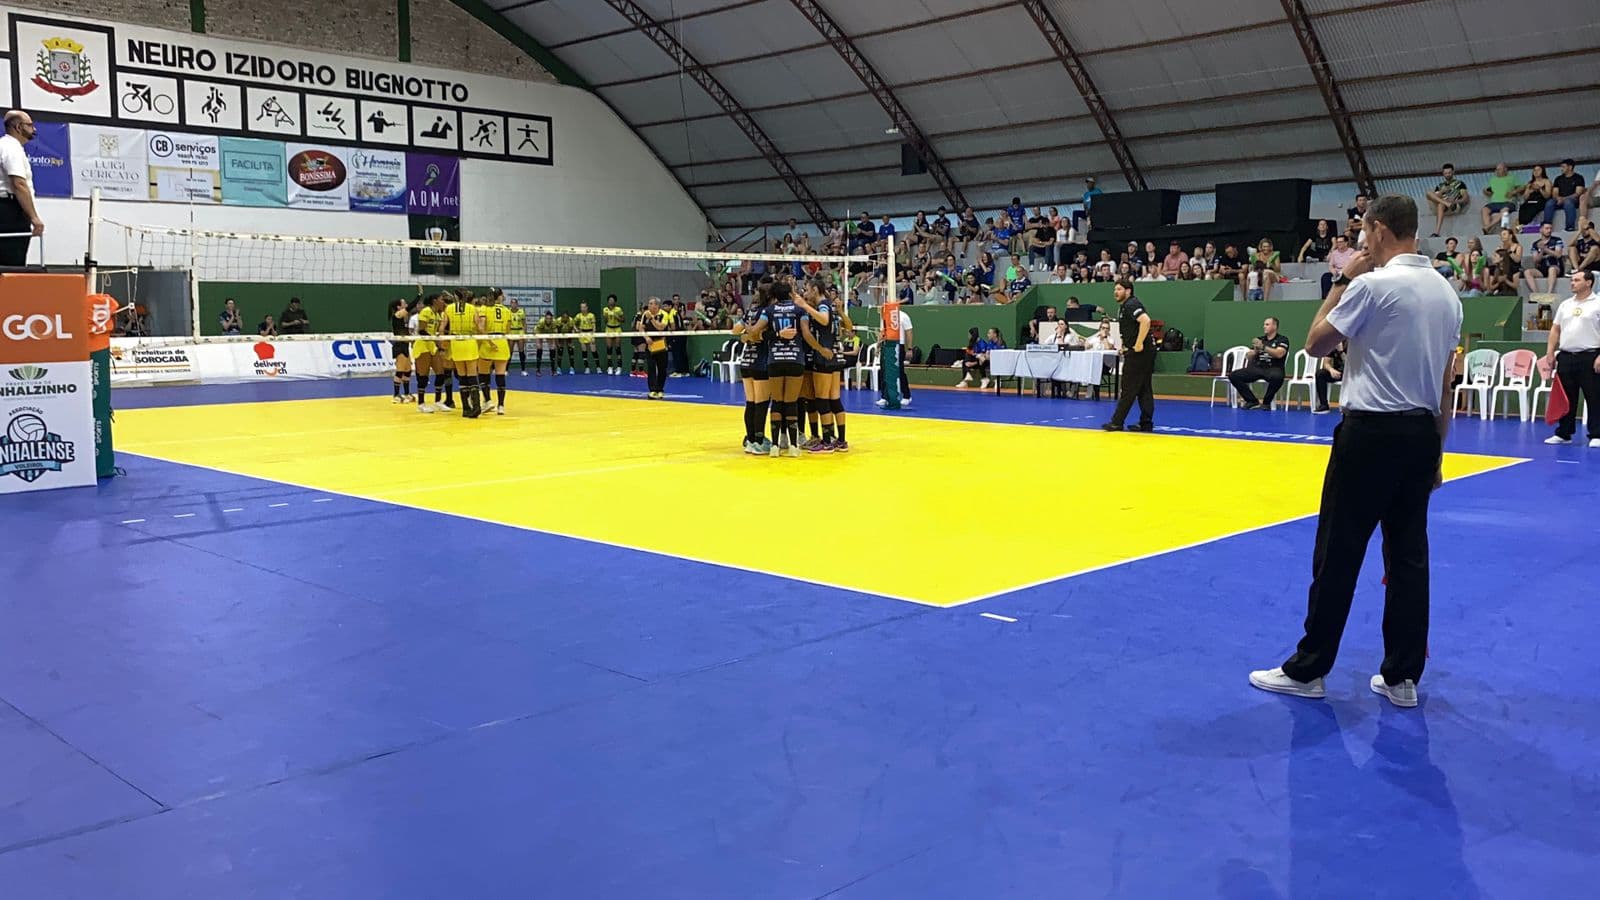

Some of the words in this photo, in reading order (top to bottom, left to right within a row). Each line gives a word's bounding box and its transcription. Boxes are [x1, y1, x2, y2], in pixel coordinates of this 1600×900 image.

[127, 38, 217, 72] NEURO
[225, 52, 336, 86] IZIDORO
[345, 68, 469, 102] BUGNOTTO
[155, 140, 168, 152] CB
[175, 142, 217, 155] serviços
[95, 160, 127, 171] LUIGI
[231, 158, 275, 171] FACILITA
[81, 168, 141, 181] CERICATO
[443, 196, 459, 207] net
[495, 307, 502, 320] 8
[2, 313, 73, 340] GOL
[332, 339, 393, 361] CIT
[135, 355, 189, 364] SOROCABA
[253, 360, 287, 369] delivery
[337, 361, 387, 369] TRANSPORTE
